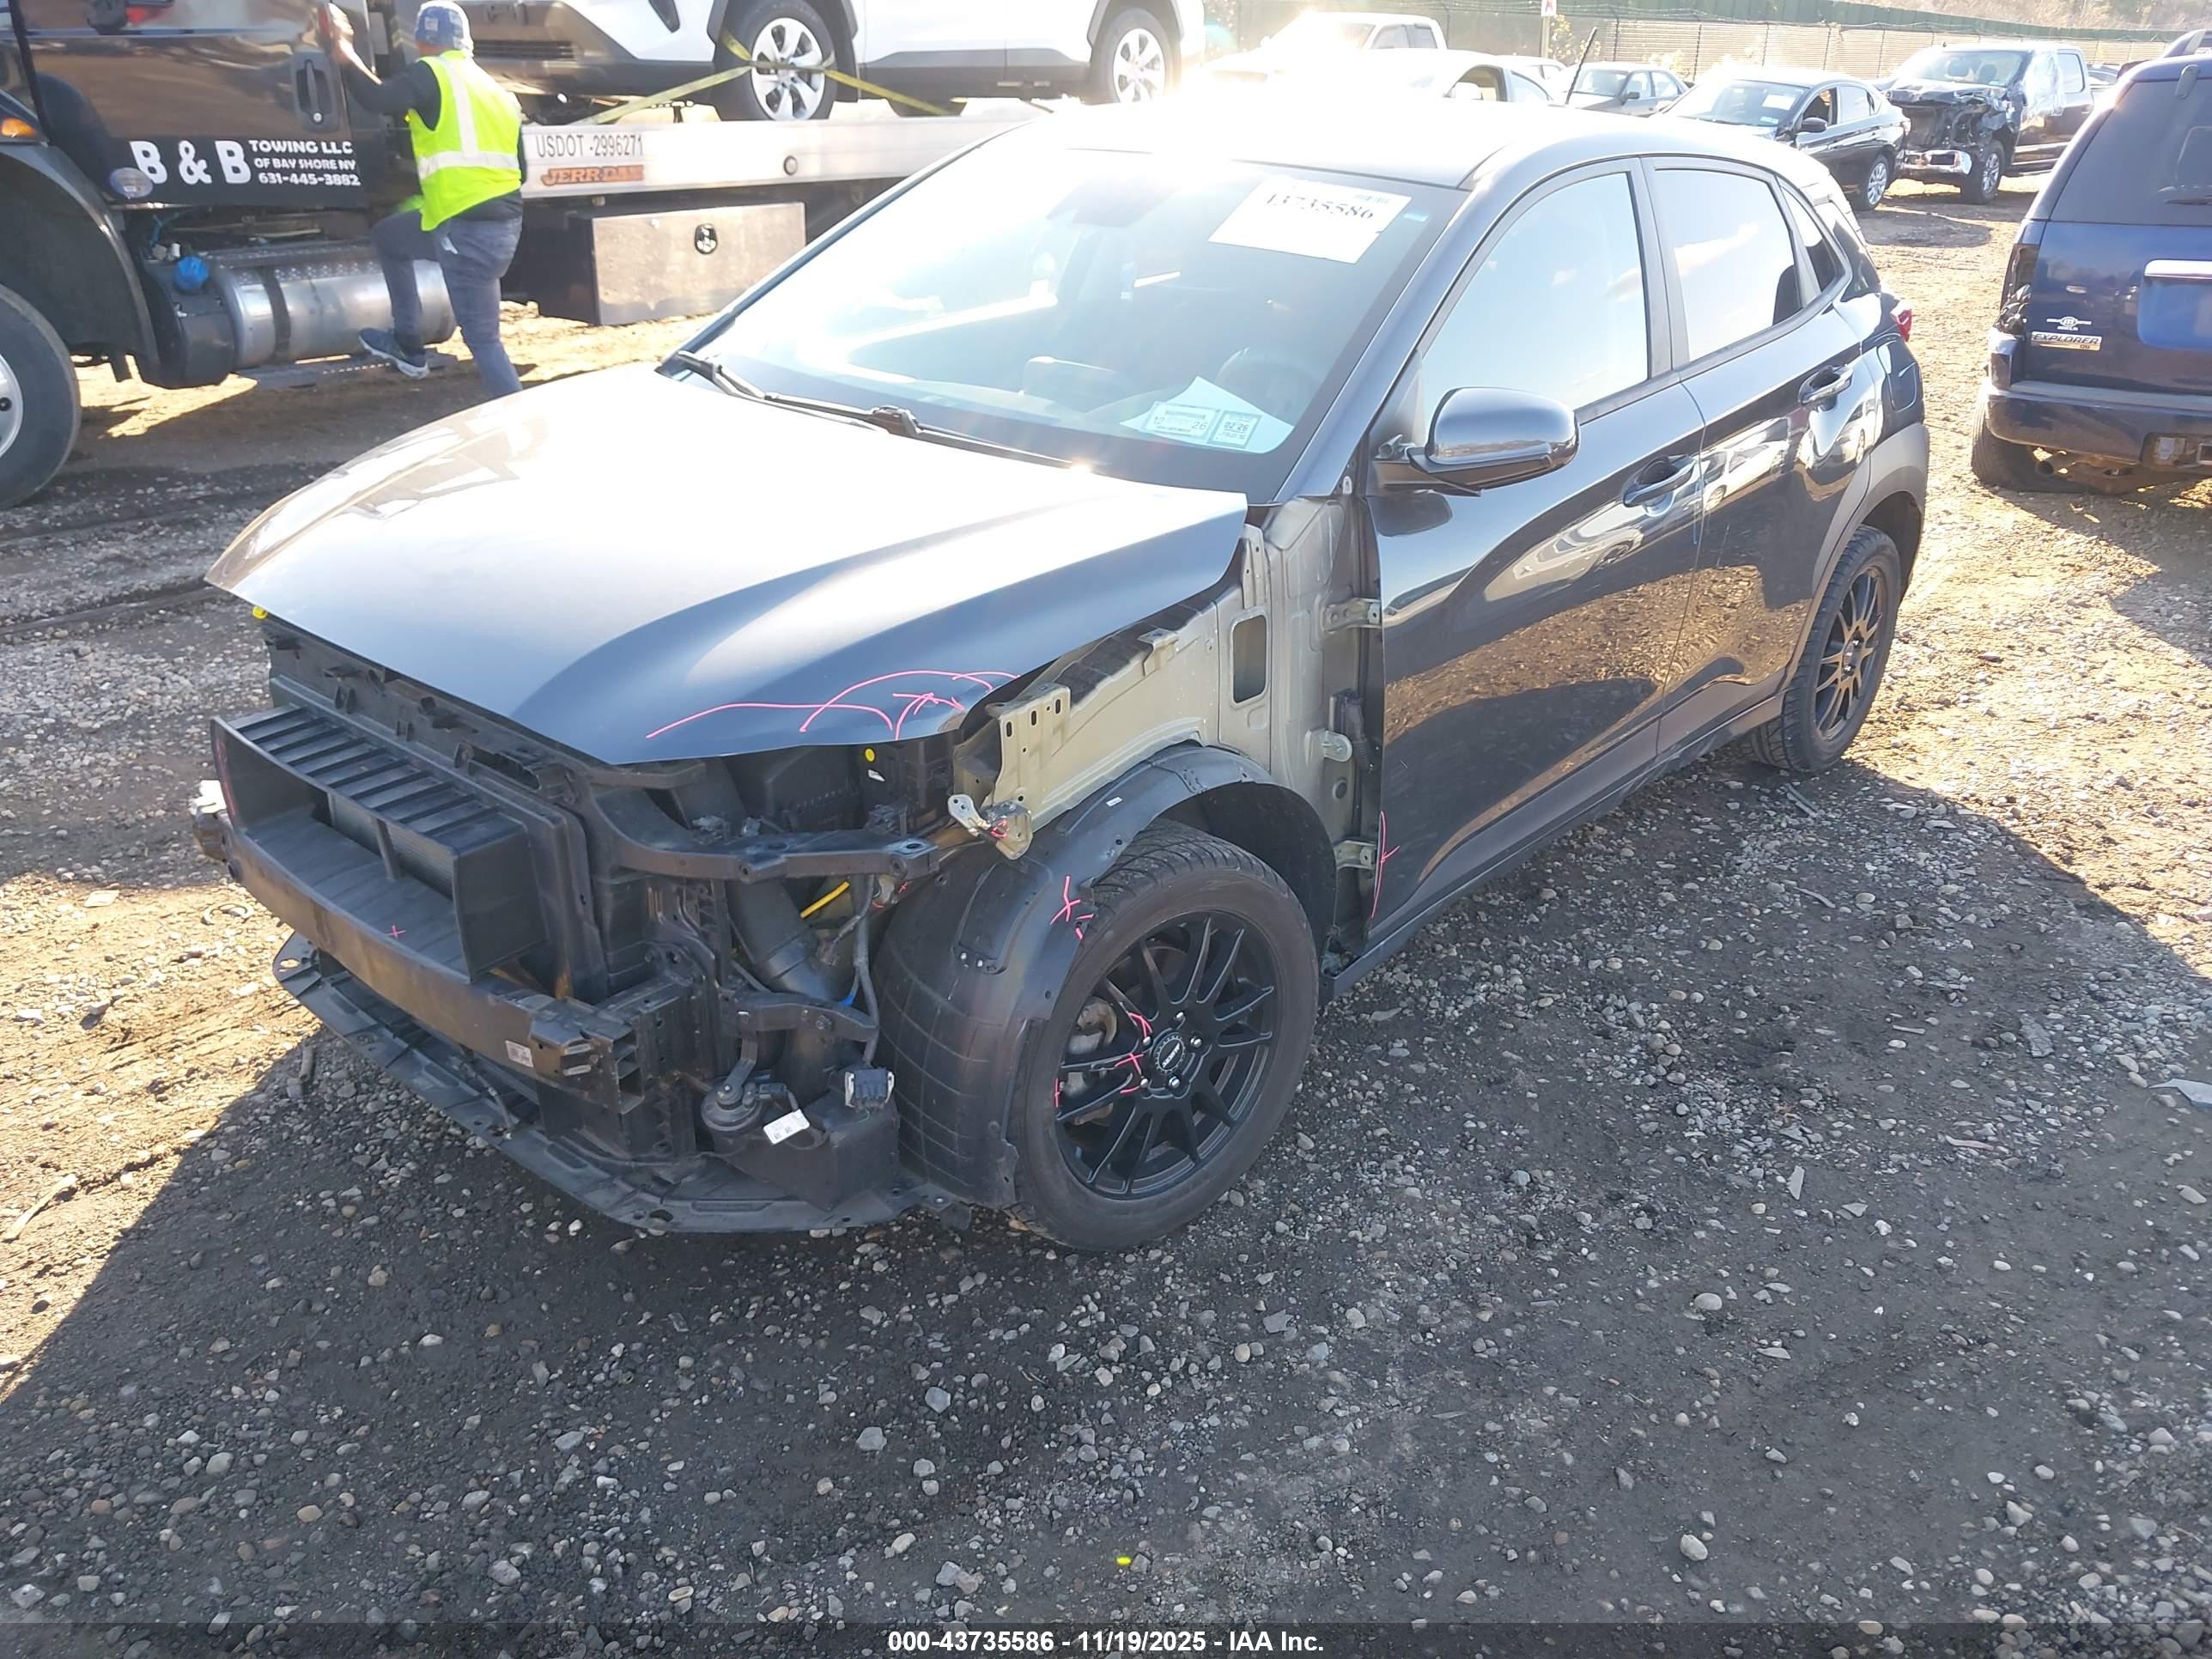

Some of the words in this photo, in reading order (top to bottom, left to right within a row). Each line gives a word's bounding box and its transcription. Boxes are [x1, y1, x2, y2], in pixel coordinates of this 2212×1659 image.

[248, 140, 319, 154] TOWING
[321, 141, 353, 154] LLC
[536, 135, 584, 157] USDOT
[129, 141, 167, 184] B
[178, 140, 212, 185] &
[215, 141, 251, 184] B
[254, 158, 270, 168] OF
[272, 158, 296, 169] BAY
[299, 159, 337, 170] SHORE
[338, 159, 356, 171] NY
[258, 173, 361, 186] 631-445-3882
[2033, 333, 2100, 344] EXPLORER
